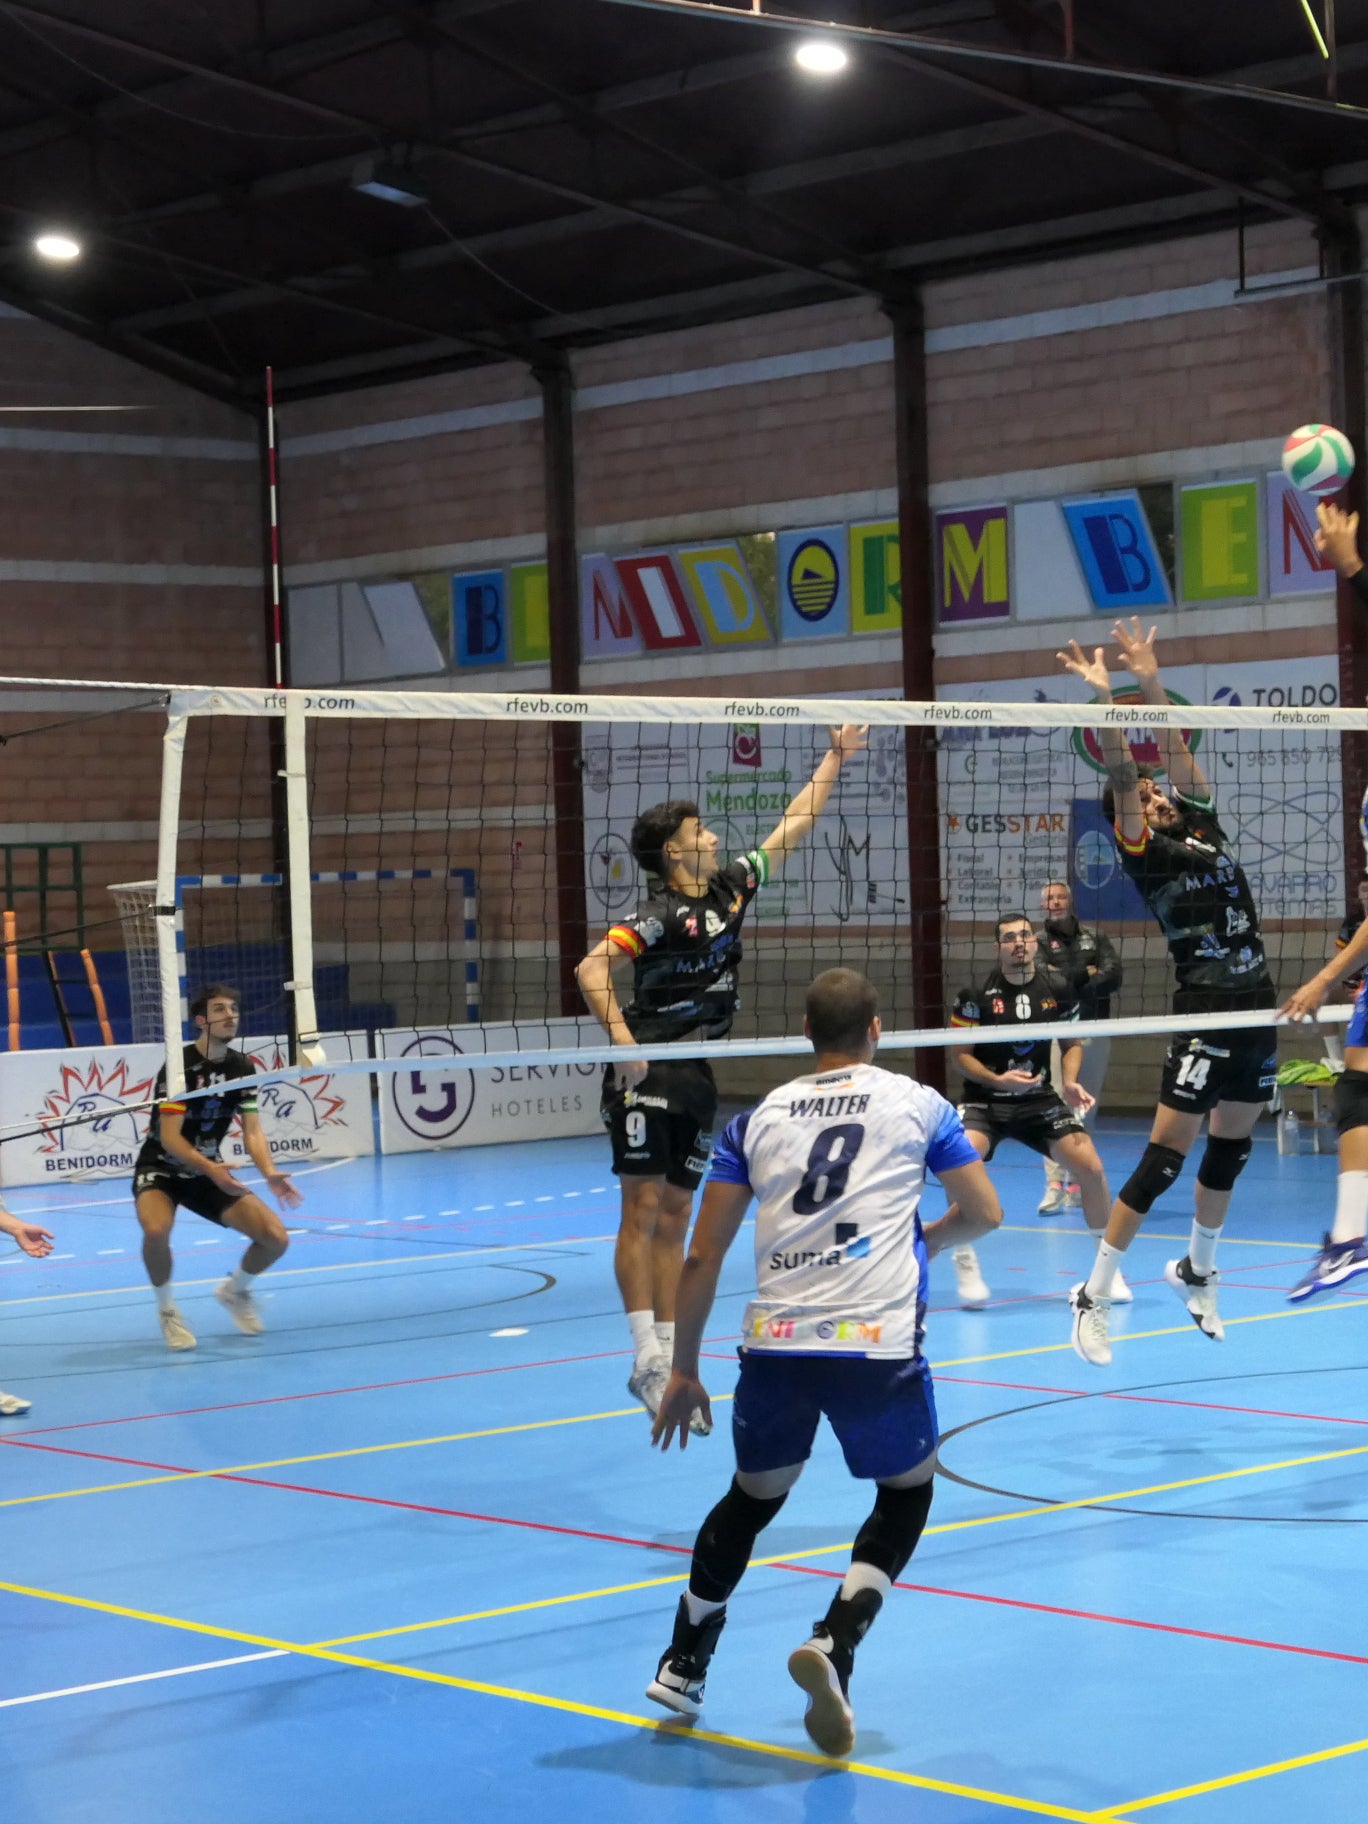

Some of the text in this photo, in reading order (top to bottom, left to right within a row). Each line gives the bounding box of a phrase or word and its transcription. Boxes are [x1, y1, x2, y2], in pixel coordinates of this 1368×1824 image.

[264, 693, 354, 710] rfe.com
[506, 697, 588, 714] rfevb.com
[724, 701, 800, 718] rfevb.com
[924, 705, 992, 720] rfevb.com
[1105, 708, 1168, 722] rfevb.com
[1272, 711, 1330, 724] rfevb.com
[705, 769, 792, 786] Supermercado
[965, 813, 1065, 834] GESSTAR
[1015, 993, 1032, 1020] 8
[1176, 1054, 1211, 1091] 14
[491, 1095, 583, 1118] HOTELES
[789, 1094, 870, 1118] WALTER
[625, 1111, 646, 1148] 9
[233, 1138, 313, 1156] BEDORM
[45, 1153, 133, 1171] BENIDORM
[792, 1123, 865, 1216] 8
[769, 1248, 840, 1271] suma
